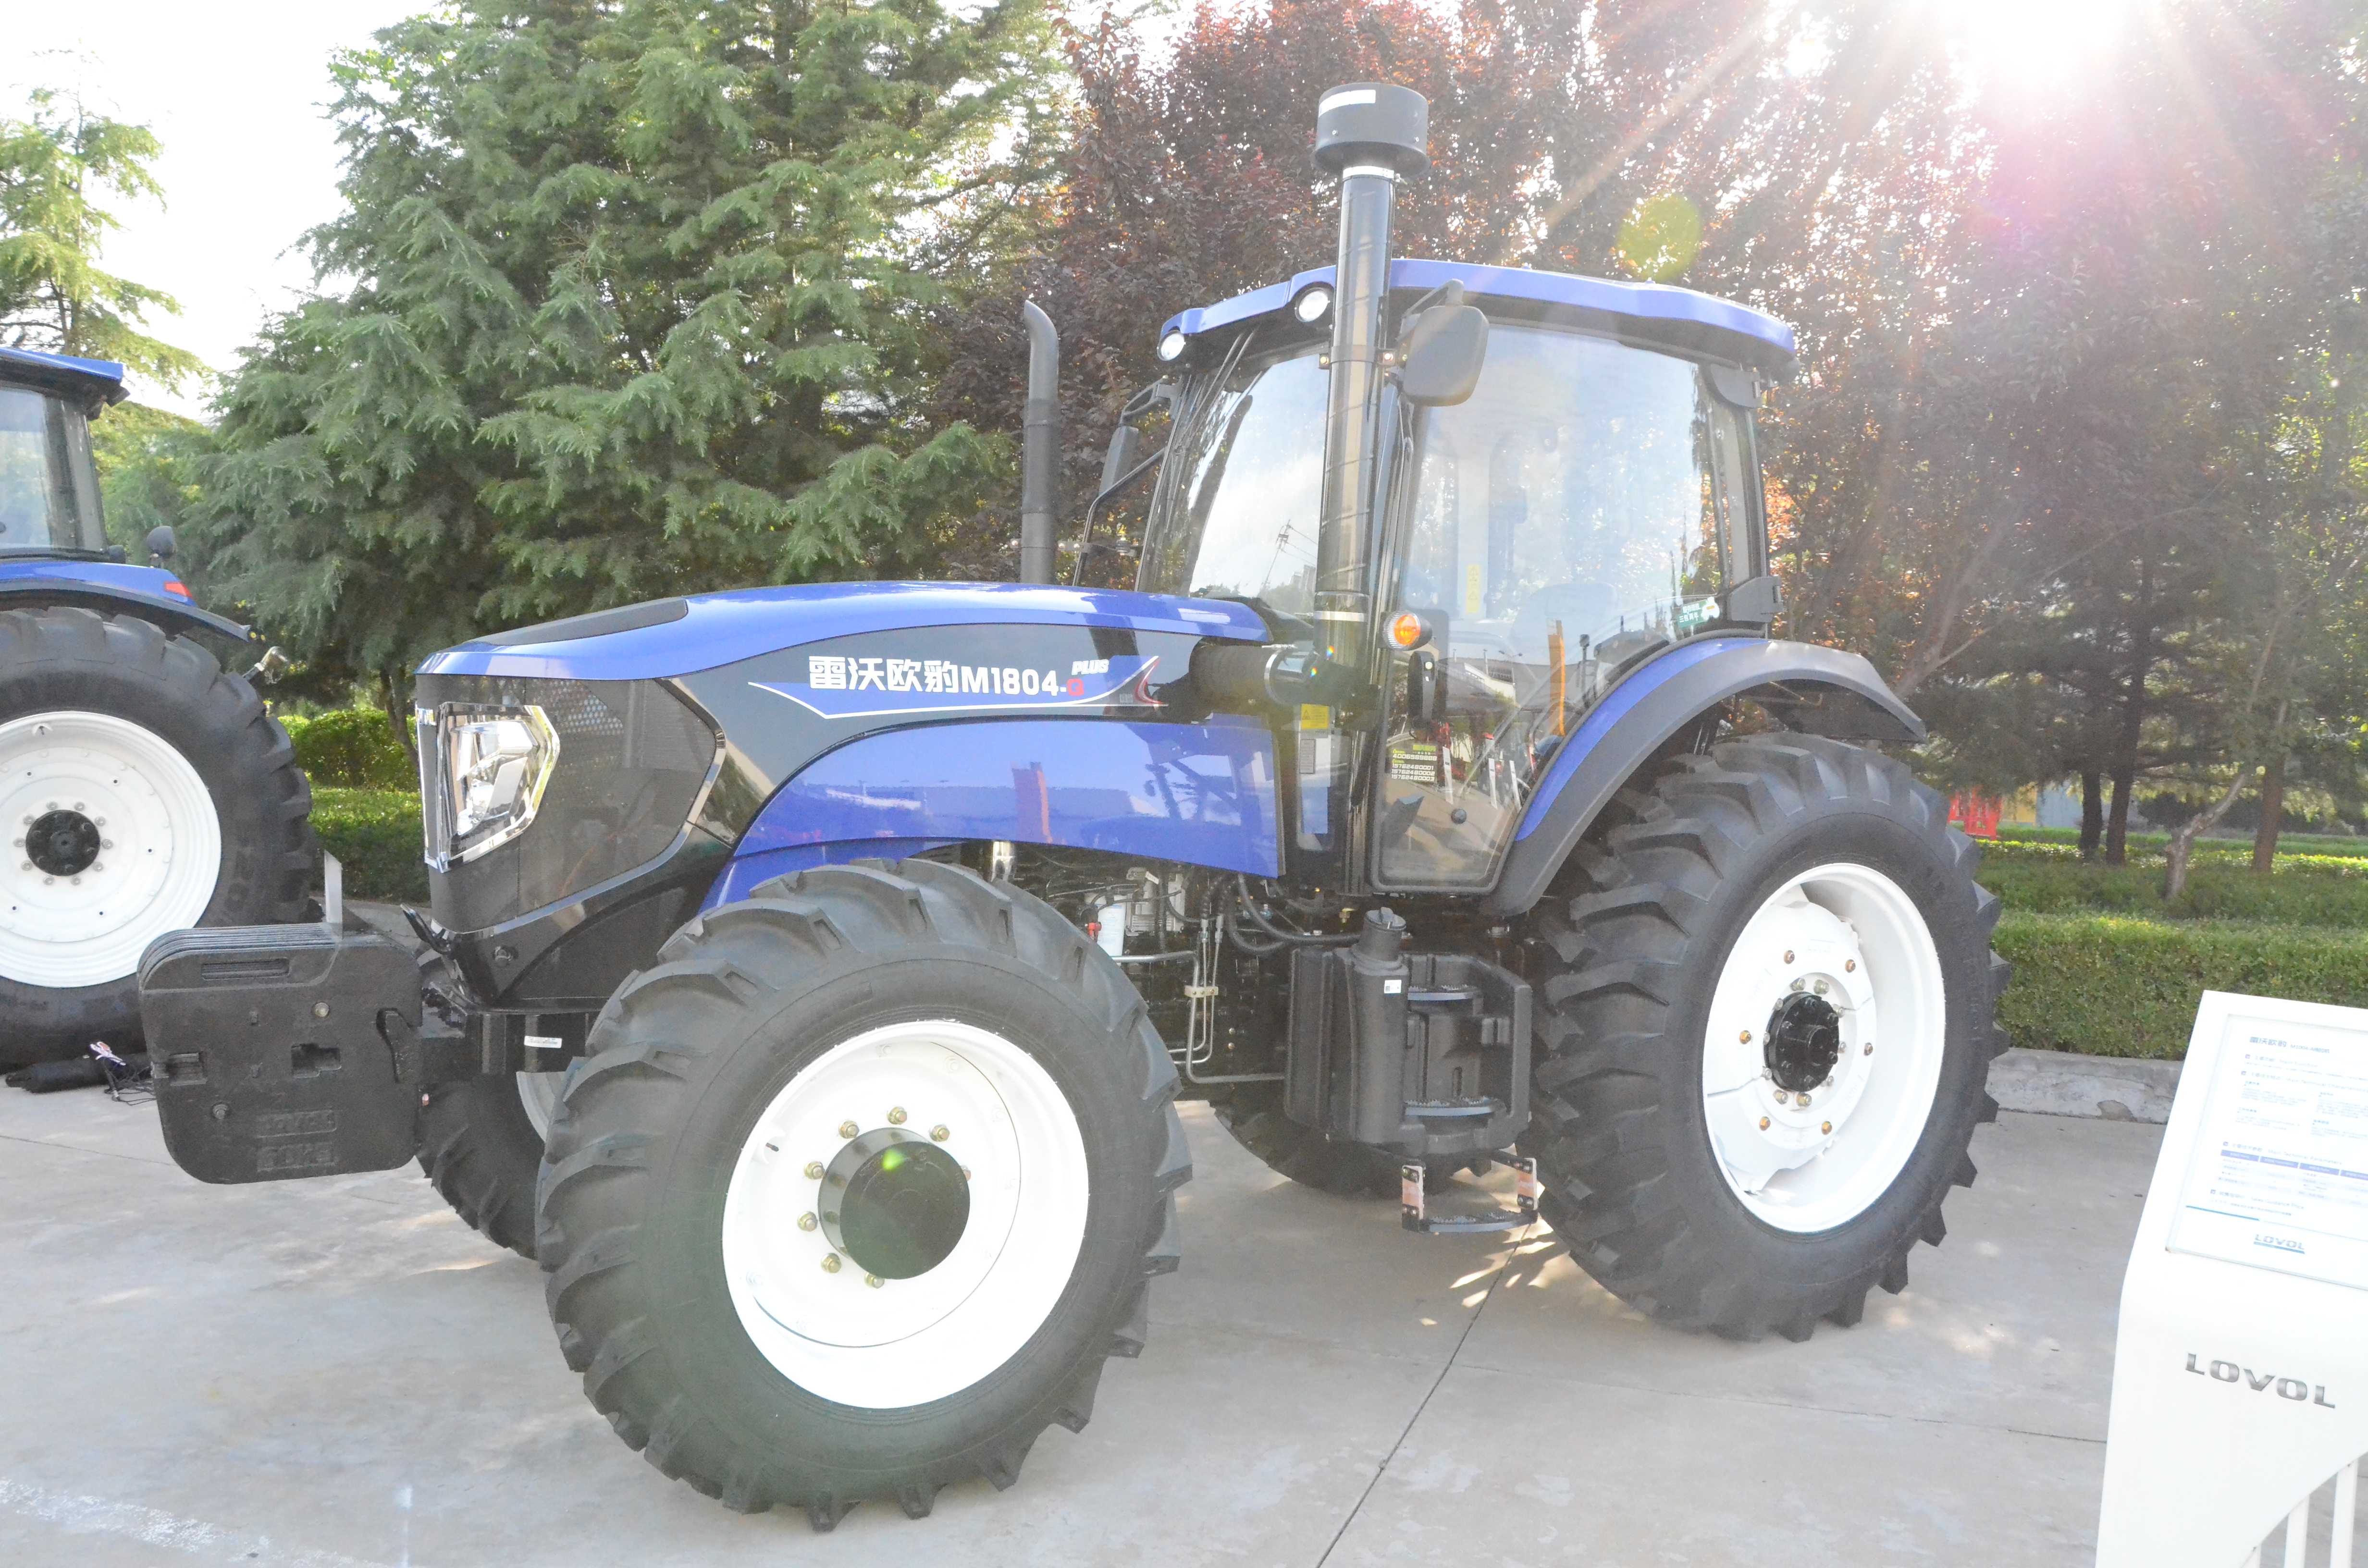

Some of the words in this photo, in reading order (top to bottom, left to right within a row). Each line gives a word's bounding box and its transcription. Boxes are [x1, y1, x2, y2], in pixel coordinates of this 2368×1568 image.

[1071, 659, 1109, 675] PLUS
[2283, 1151, 2308, 1160] Technical
[2310, 1156, 2343, 1165] Parameters
[2255, 1234, 2305, 1250] LOVOL
[2185, 1352, 2336, 1409] LOVOL
